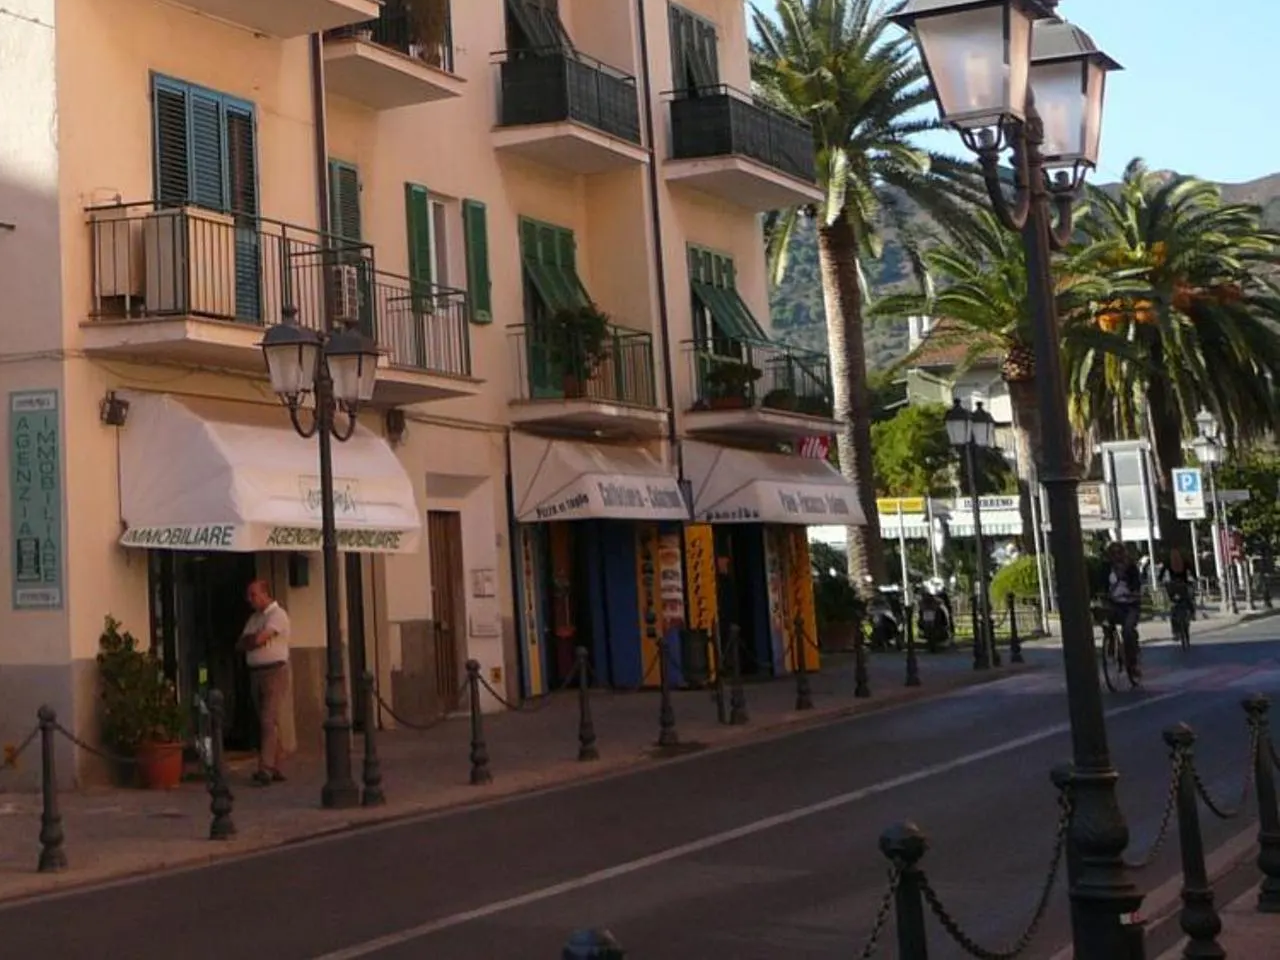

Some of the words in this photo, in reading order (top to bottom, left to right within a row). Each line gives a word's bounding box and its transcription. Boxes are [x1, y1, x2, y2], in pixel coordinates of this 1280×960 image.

[15, 416, 32, 535] AGENZIA
[36, 415, 56, 583] IMMOBILIARE
[125, 526, 236, 547] IMMOBILIARE
